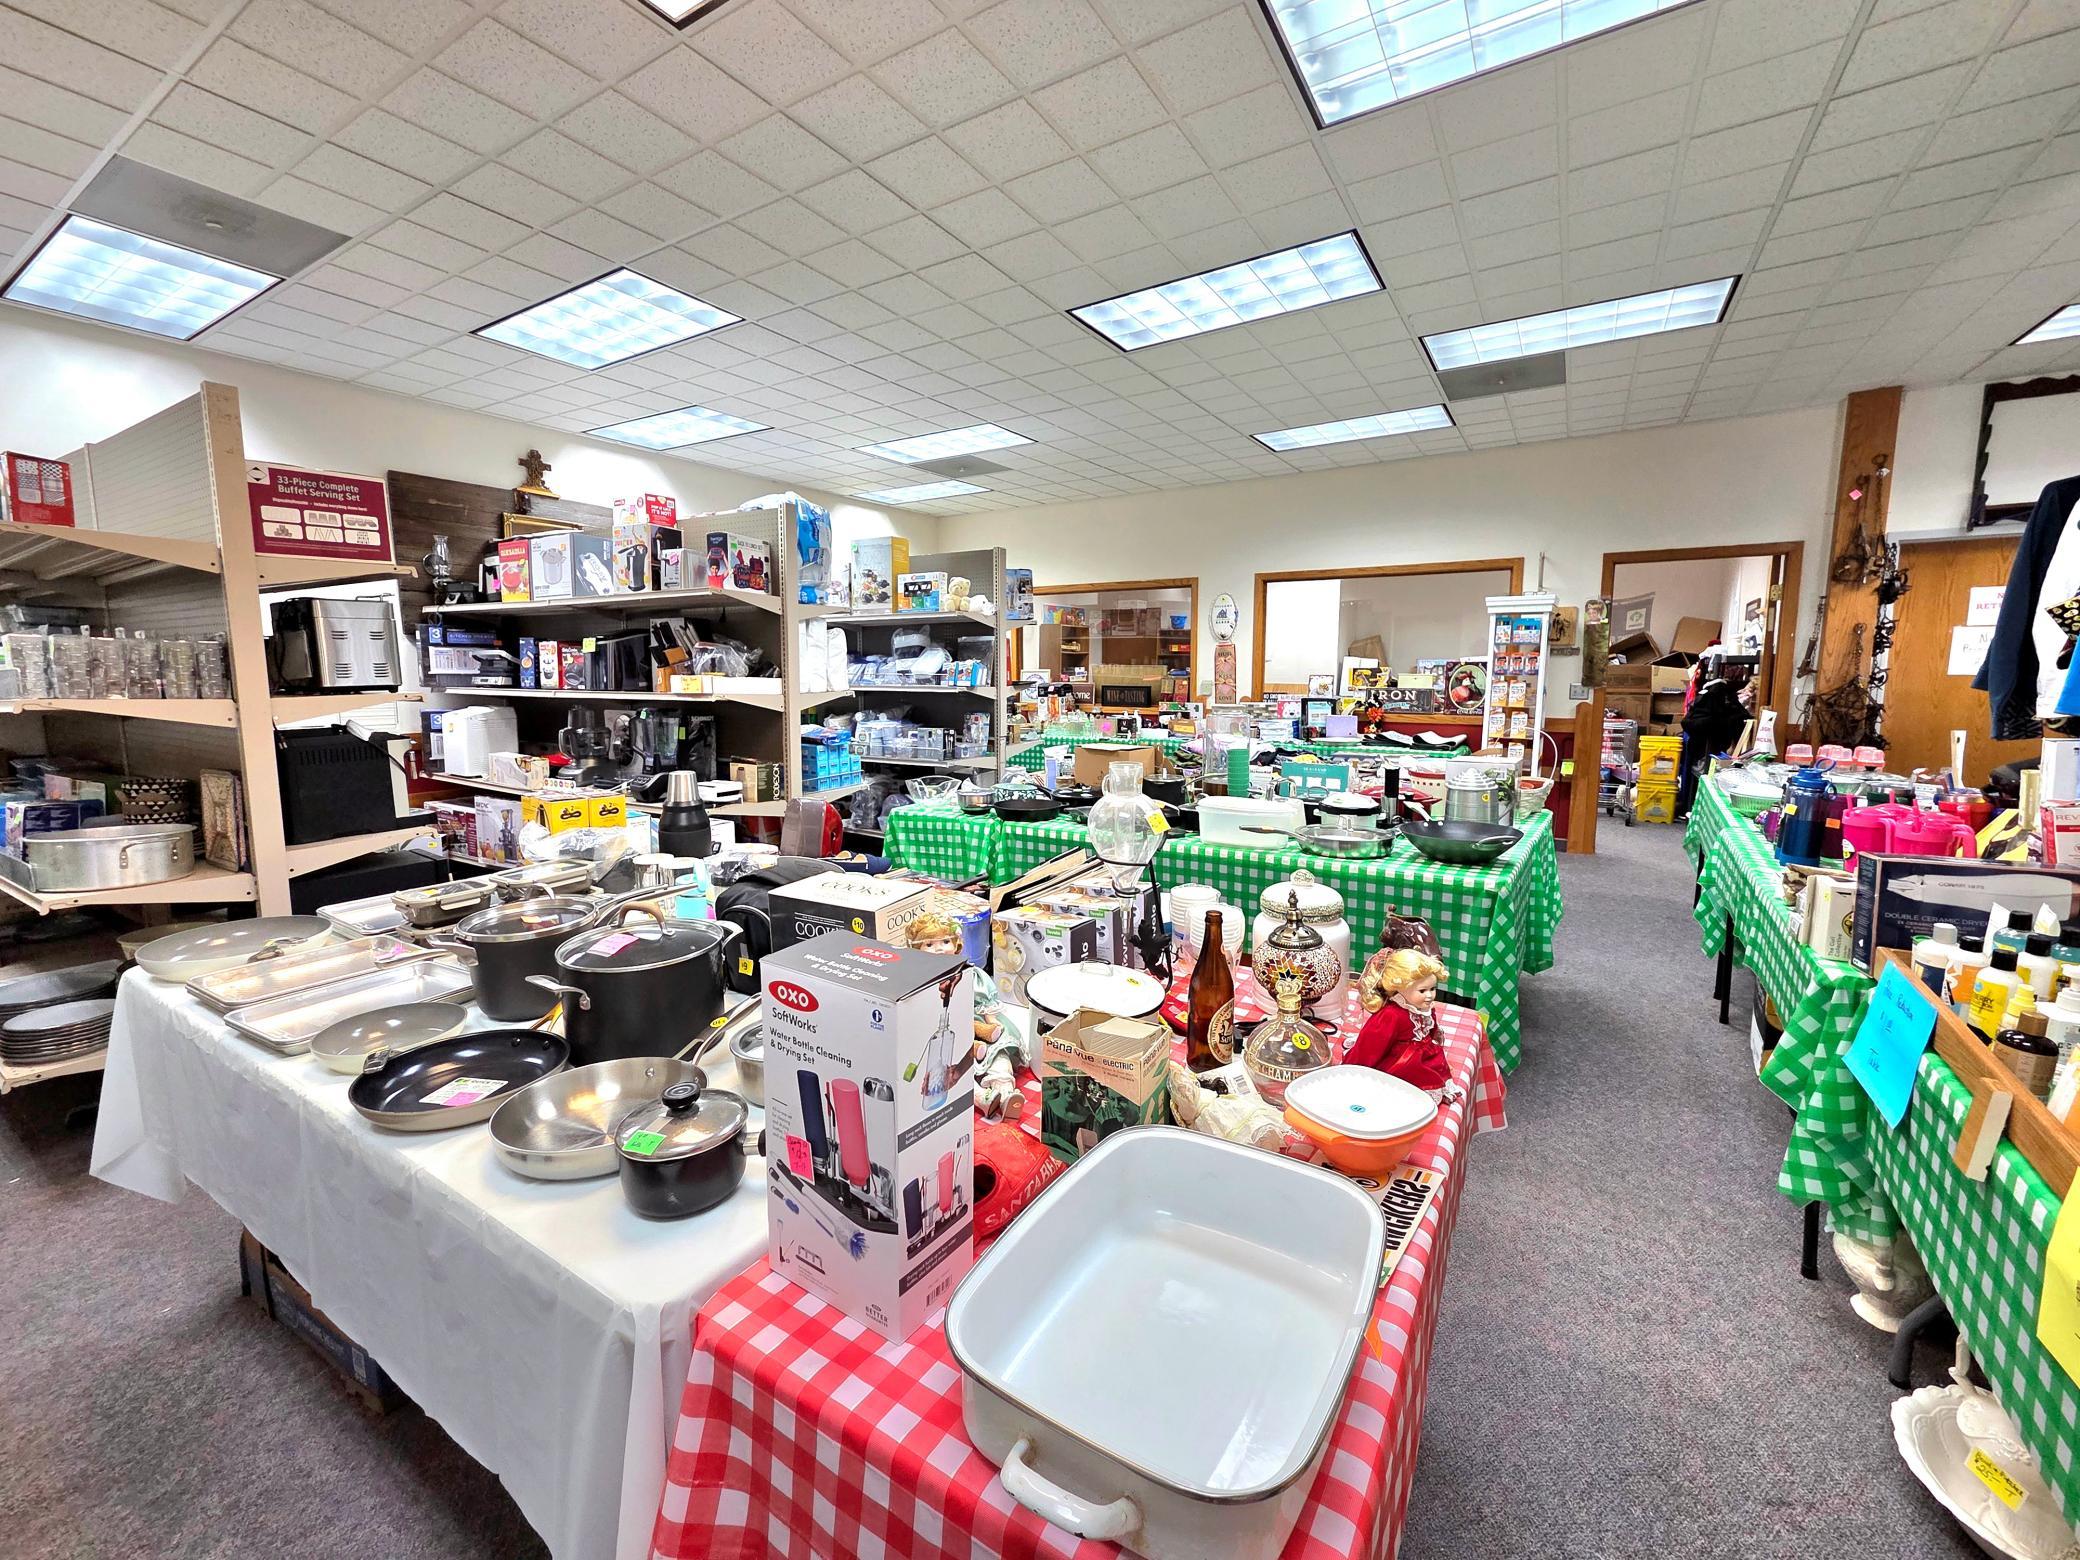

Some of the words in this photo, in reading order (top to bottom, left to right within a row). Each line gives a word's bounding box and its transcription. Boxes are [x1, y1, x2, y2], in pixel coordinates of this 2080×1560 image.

[277, 476, 317, 488] 33-Piece
[319, 481, 359, 494] Complete
[278, 485, 307, 496] Buffet
[309, 489, 344, 501] Serving
[346, 492, 361, 502] Set
[1976, 602, 2002, 610] RET
[1885, 912, 1919, 920] DOUBLE
[1921, 914, 1960, 925] CERAMIC
[840, 952, 884, 968] SoftWorks
[862, 948, 893, 959] OXO
[804, 954, 825, 964] Water
[826, 959, 852, 973] Bottle
[852, 966, 889, 982] Cleaning
[819, 965, 846, 978] Drying
[846, 972, 862, 981] Set
[777, 986, 809, 1008] OXO
[772, 1007, 817, 1034] SoftWorks
[770, 1026, 792, 1043] Water
[792, 1034, 814, 1052] Bottle
[816, 1046, 852, 1068] Cleaning
[770, 1040, 776, 1048] &
[777, 1042, 802, 1062] Drying
[802, 1053, 816, 1064] Set
[985, 1180, 1041, 1228] SANTA
[866, 1306, 888, 1322] BETTER
